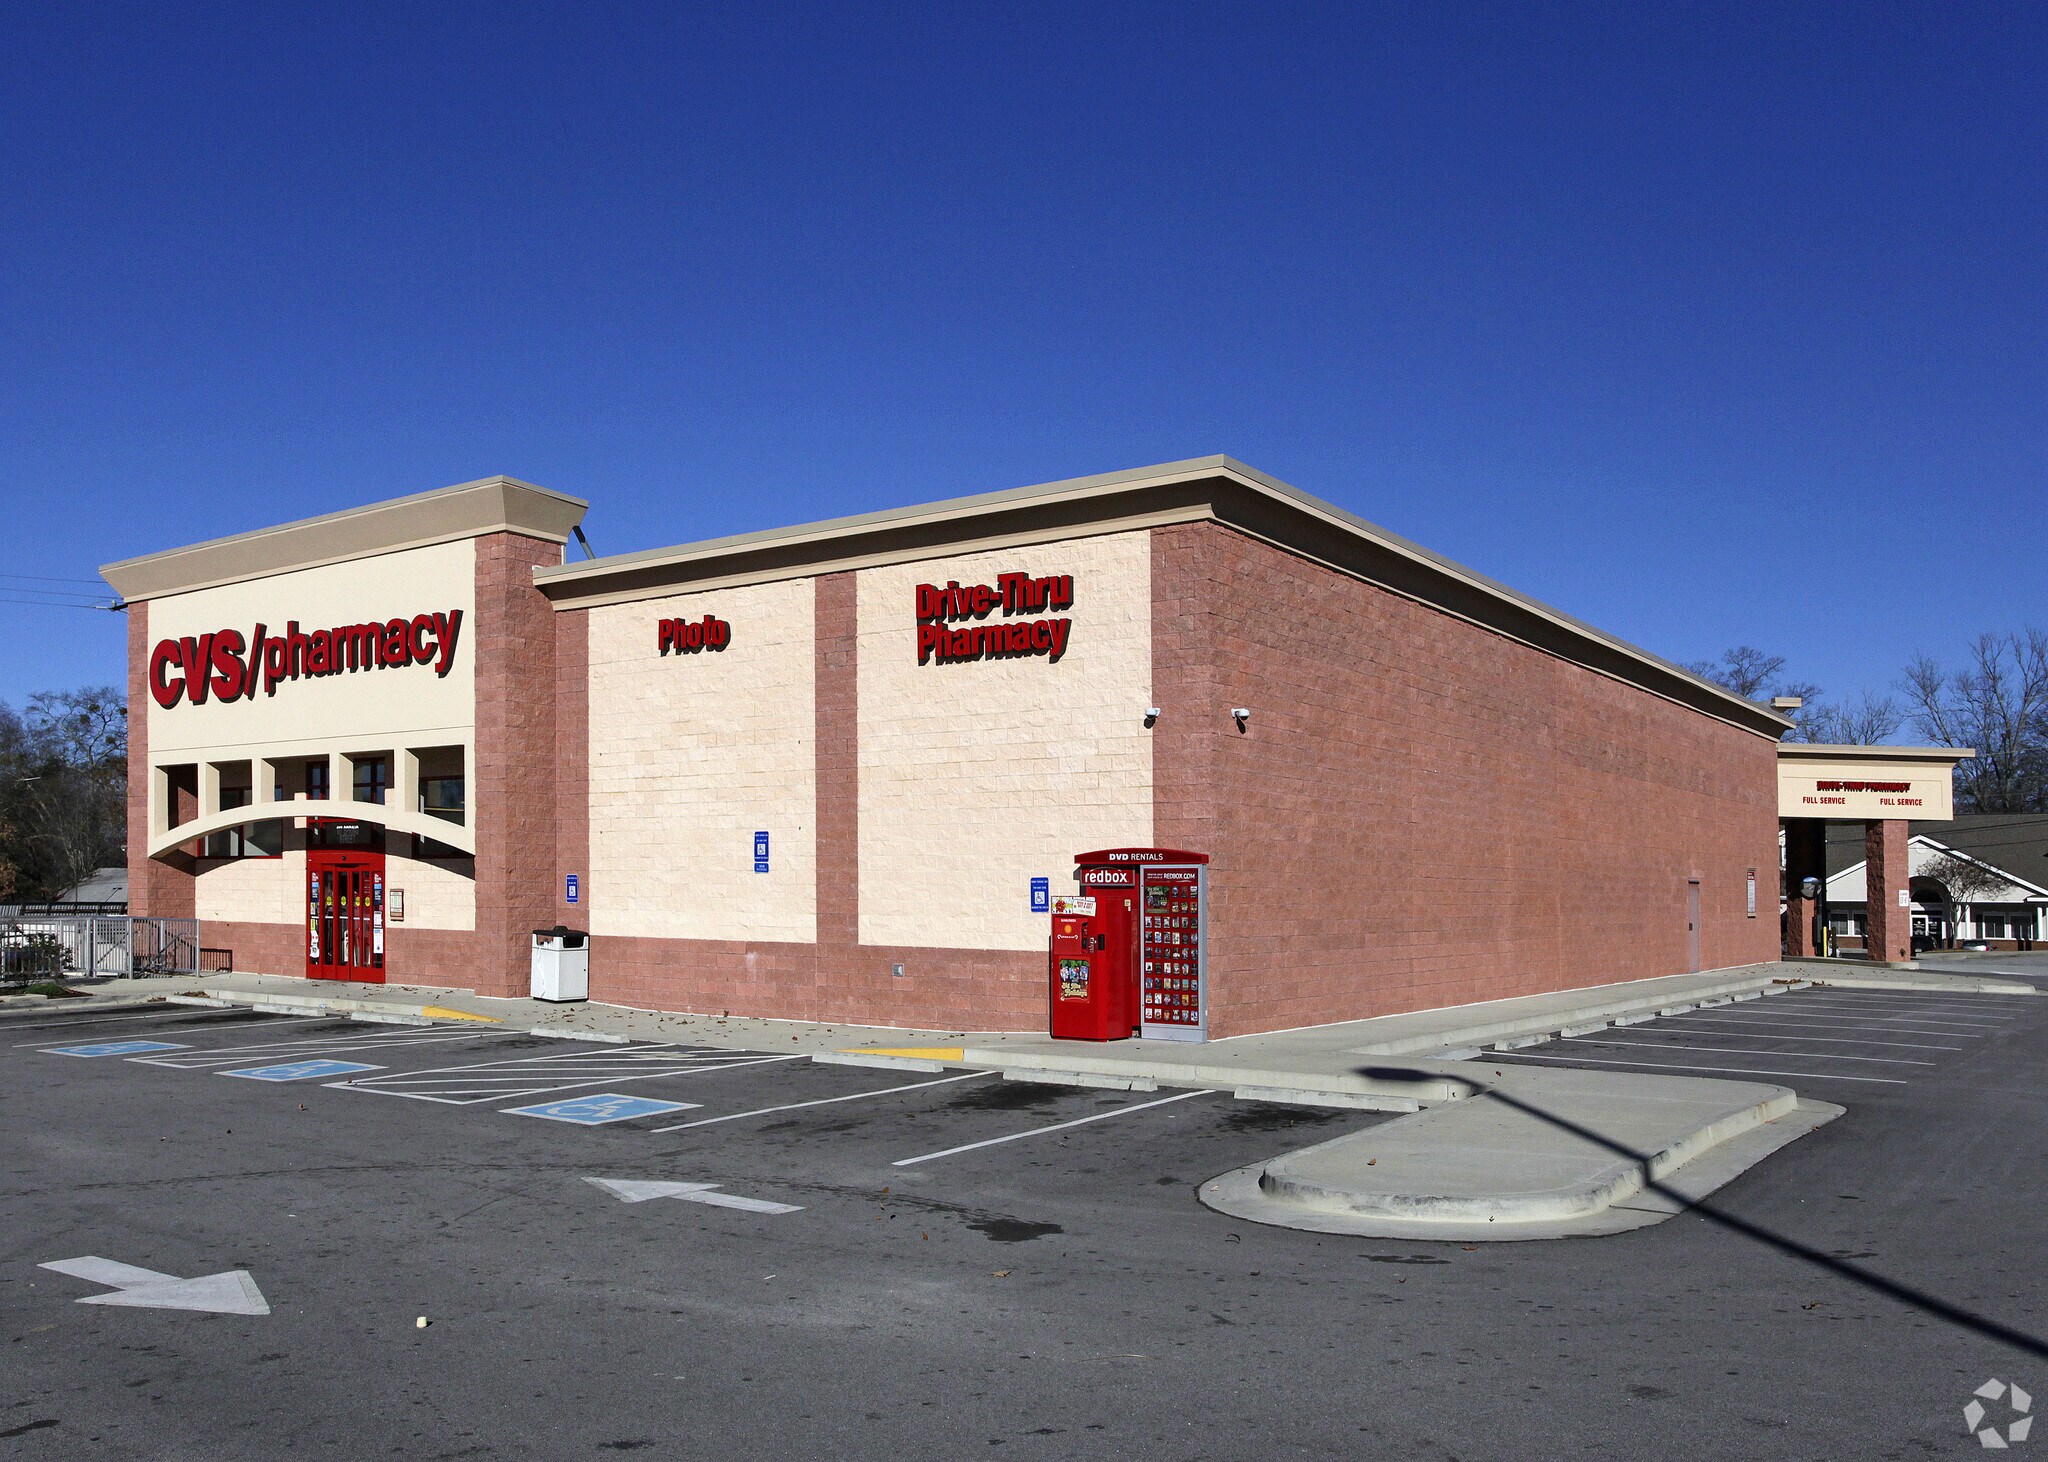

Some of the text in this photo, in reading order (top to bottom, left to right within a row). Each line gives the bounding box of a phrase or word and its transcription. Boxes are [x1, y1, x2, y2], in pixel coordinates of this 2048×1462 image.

[916, 572, 1073, 624] Drive-Thru
[658, 614, 730, 655] Photo
[917, 618, 1072, 665] Pharmacy
[150, 609, 463, 709] CVS/pharmacy
[1802, 796, 1818, 804] FULL
[1897, 798, 1923, 806] SERVICE
[1130, 853, 1164, 861] RENTALS
[1084, 870, 1128, 883] redbox
